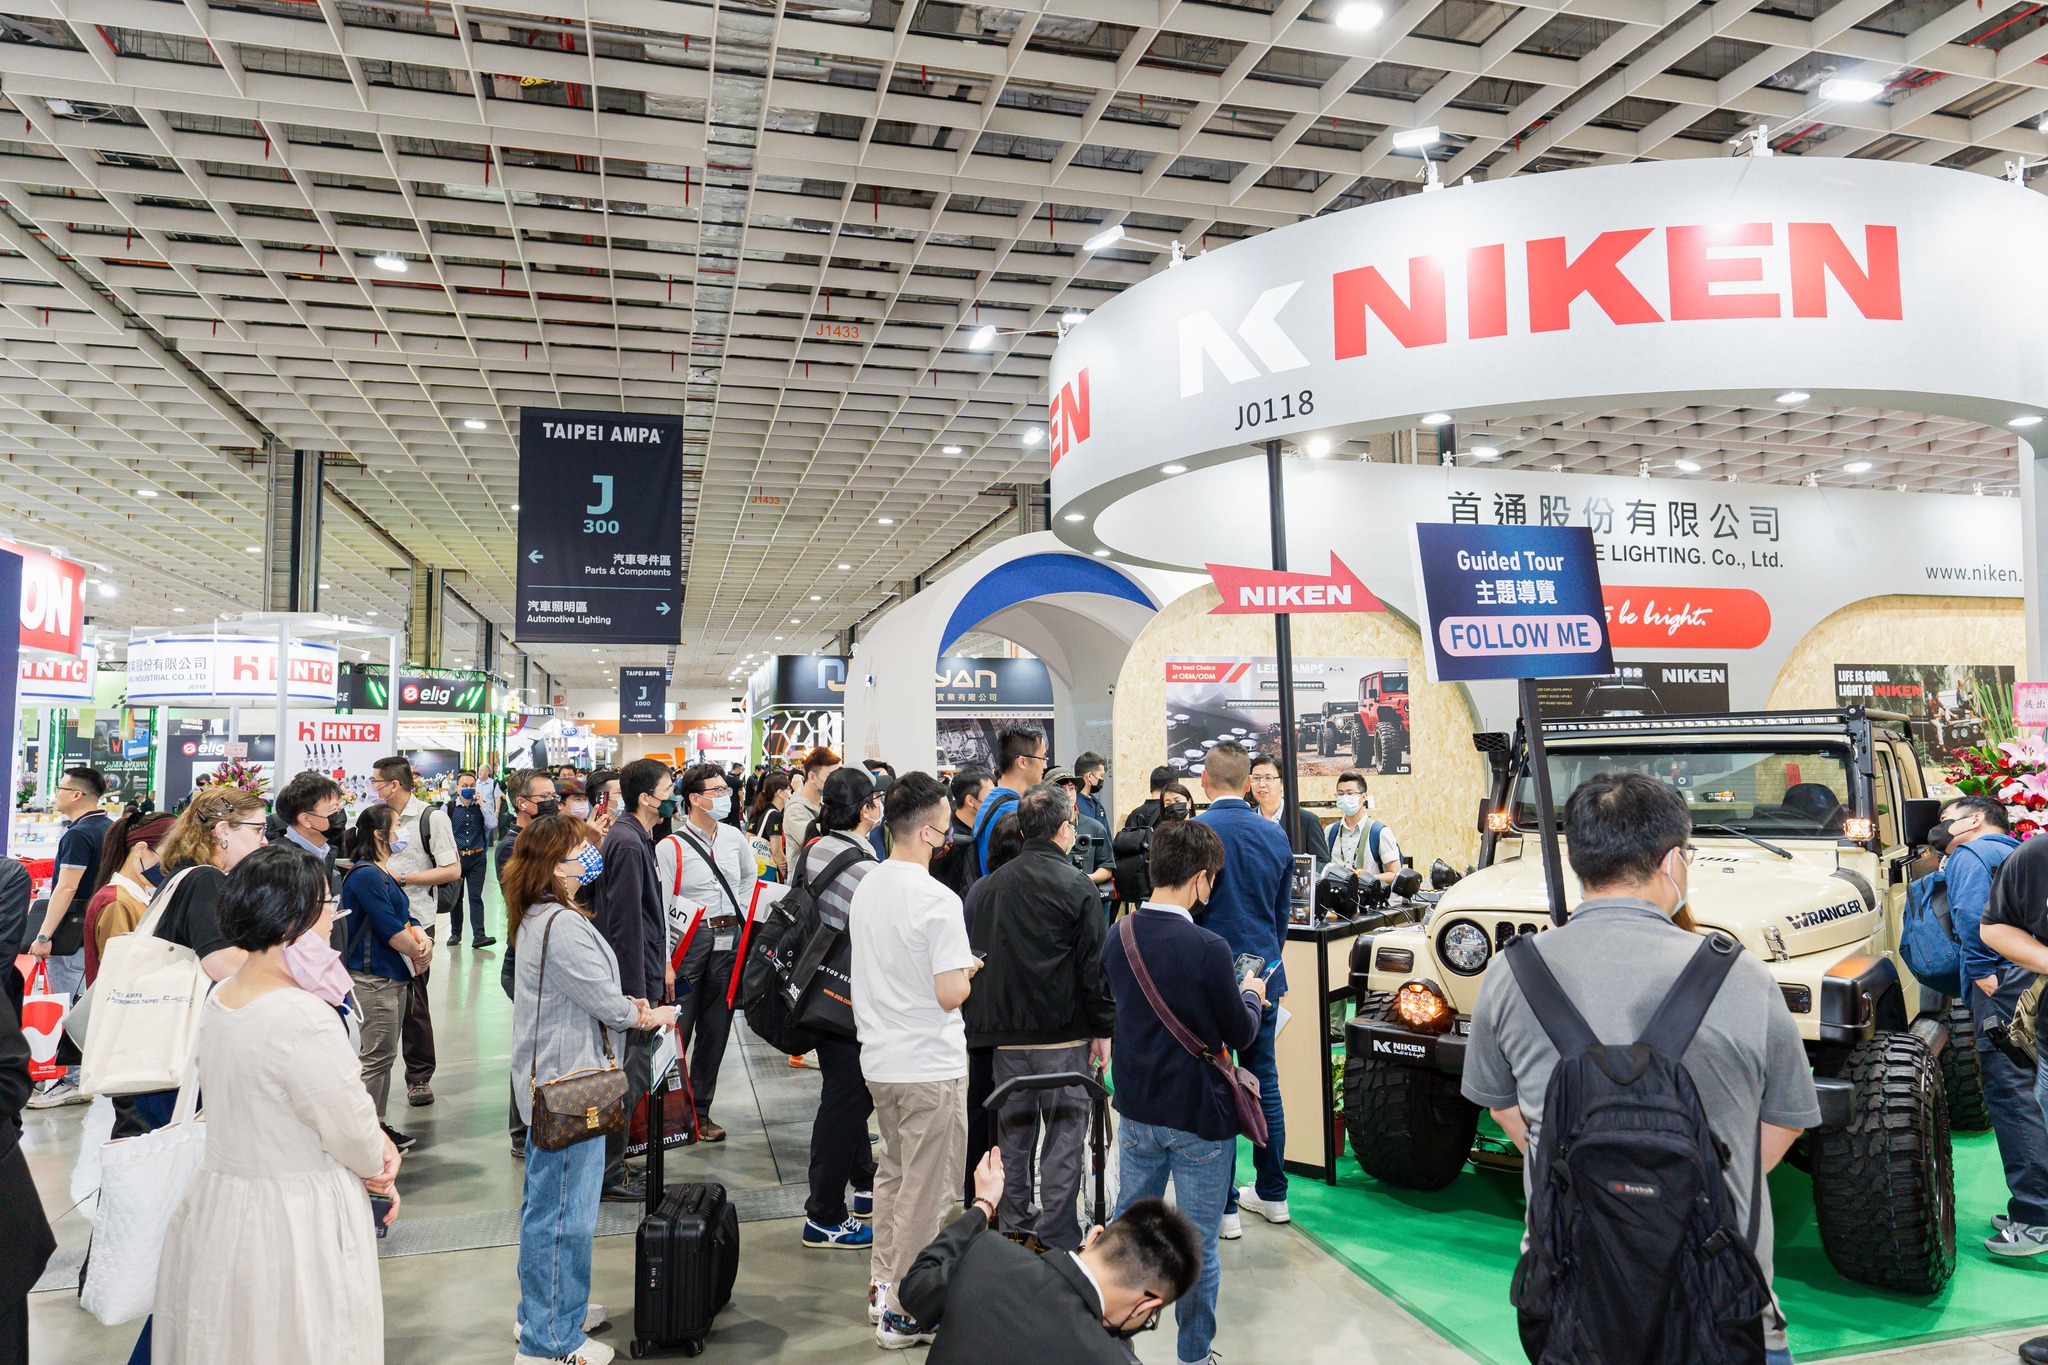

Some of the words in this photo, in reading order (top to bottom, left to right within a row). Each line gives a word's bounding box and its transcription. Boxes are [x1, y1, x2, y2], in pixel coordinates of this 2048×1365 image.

[1333, 222, 1903, 361] NIKEN
[816, 323, 860, 339] J1433
[1235, 388, 1314, 431] J0118
[542, 422, 604, 441] TAIPEI
[610, 426, 661, 444] AMPA
[586, 474, 614, 515] J
[752, 495, 780, 505] J1433
[1448, 490, 1780, 542] 首通股份有限公司
[583, 519, 620, 534] 300
[613, 553, 671, 566] 汽車零件區
[1457, 549, 1521, 571] Guided
[1523, 551, 1564, 571] Tour
[1612, 545, 1706, 565] LIGHTING.
[1713, 548, 1745, 569] Co.,
[1752, 550, 1784, 568] Ltd.
[585, 566, 607, 575] Parts
[609, 567, 616, 575] &
[618, 566, 671, 577] Components
[1925, 563, 2023, 582] www.niken.
[1240, 585, 1351, 606] NIKEN
[1475, 579, 1558, 605] 主題導覽
[527, 600, 588, 612] 汽車照明區
[1619, 599, 1638, 625] be
[526, 614, 575, 624] Automotive
[577, 615, 611, 625] Lighting
[1450, 623, 1549, 650] FOLLOW
[1558, 621, 1592, 647] ME
[1178, 673, 1216, 681] OEM/ODM
[1661, 668, 1726, 684] NIKEN
[1837, 670, 1855, 682] LIFE
[1855, 671, 1865, 682] IS
[1865, 670, 1890, 682] GOOD.
[637, 686, 647, 700] J
[937, 693, 997, 702] 實業有限公司
[1838, 684, 1863, 697] LIGHT
[1864, 684, 1874, 697] IS
[1874, 685, 1923, 697] NIKEN
[710, 731, 733, 742] NHC
[1786, 899, 1864, 930] WRANGLER
[826, 968, 839, 977] YOU
[1393, 1042, 1426, 1053] NIKEN
